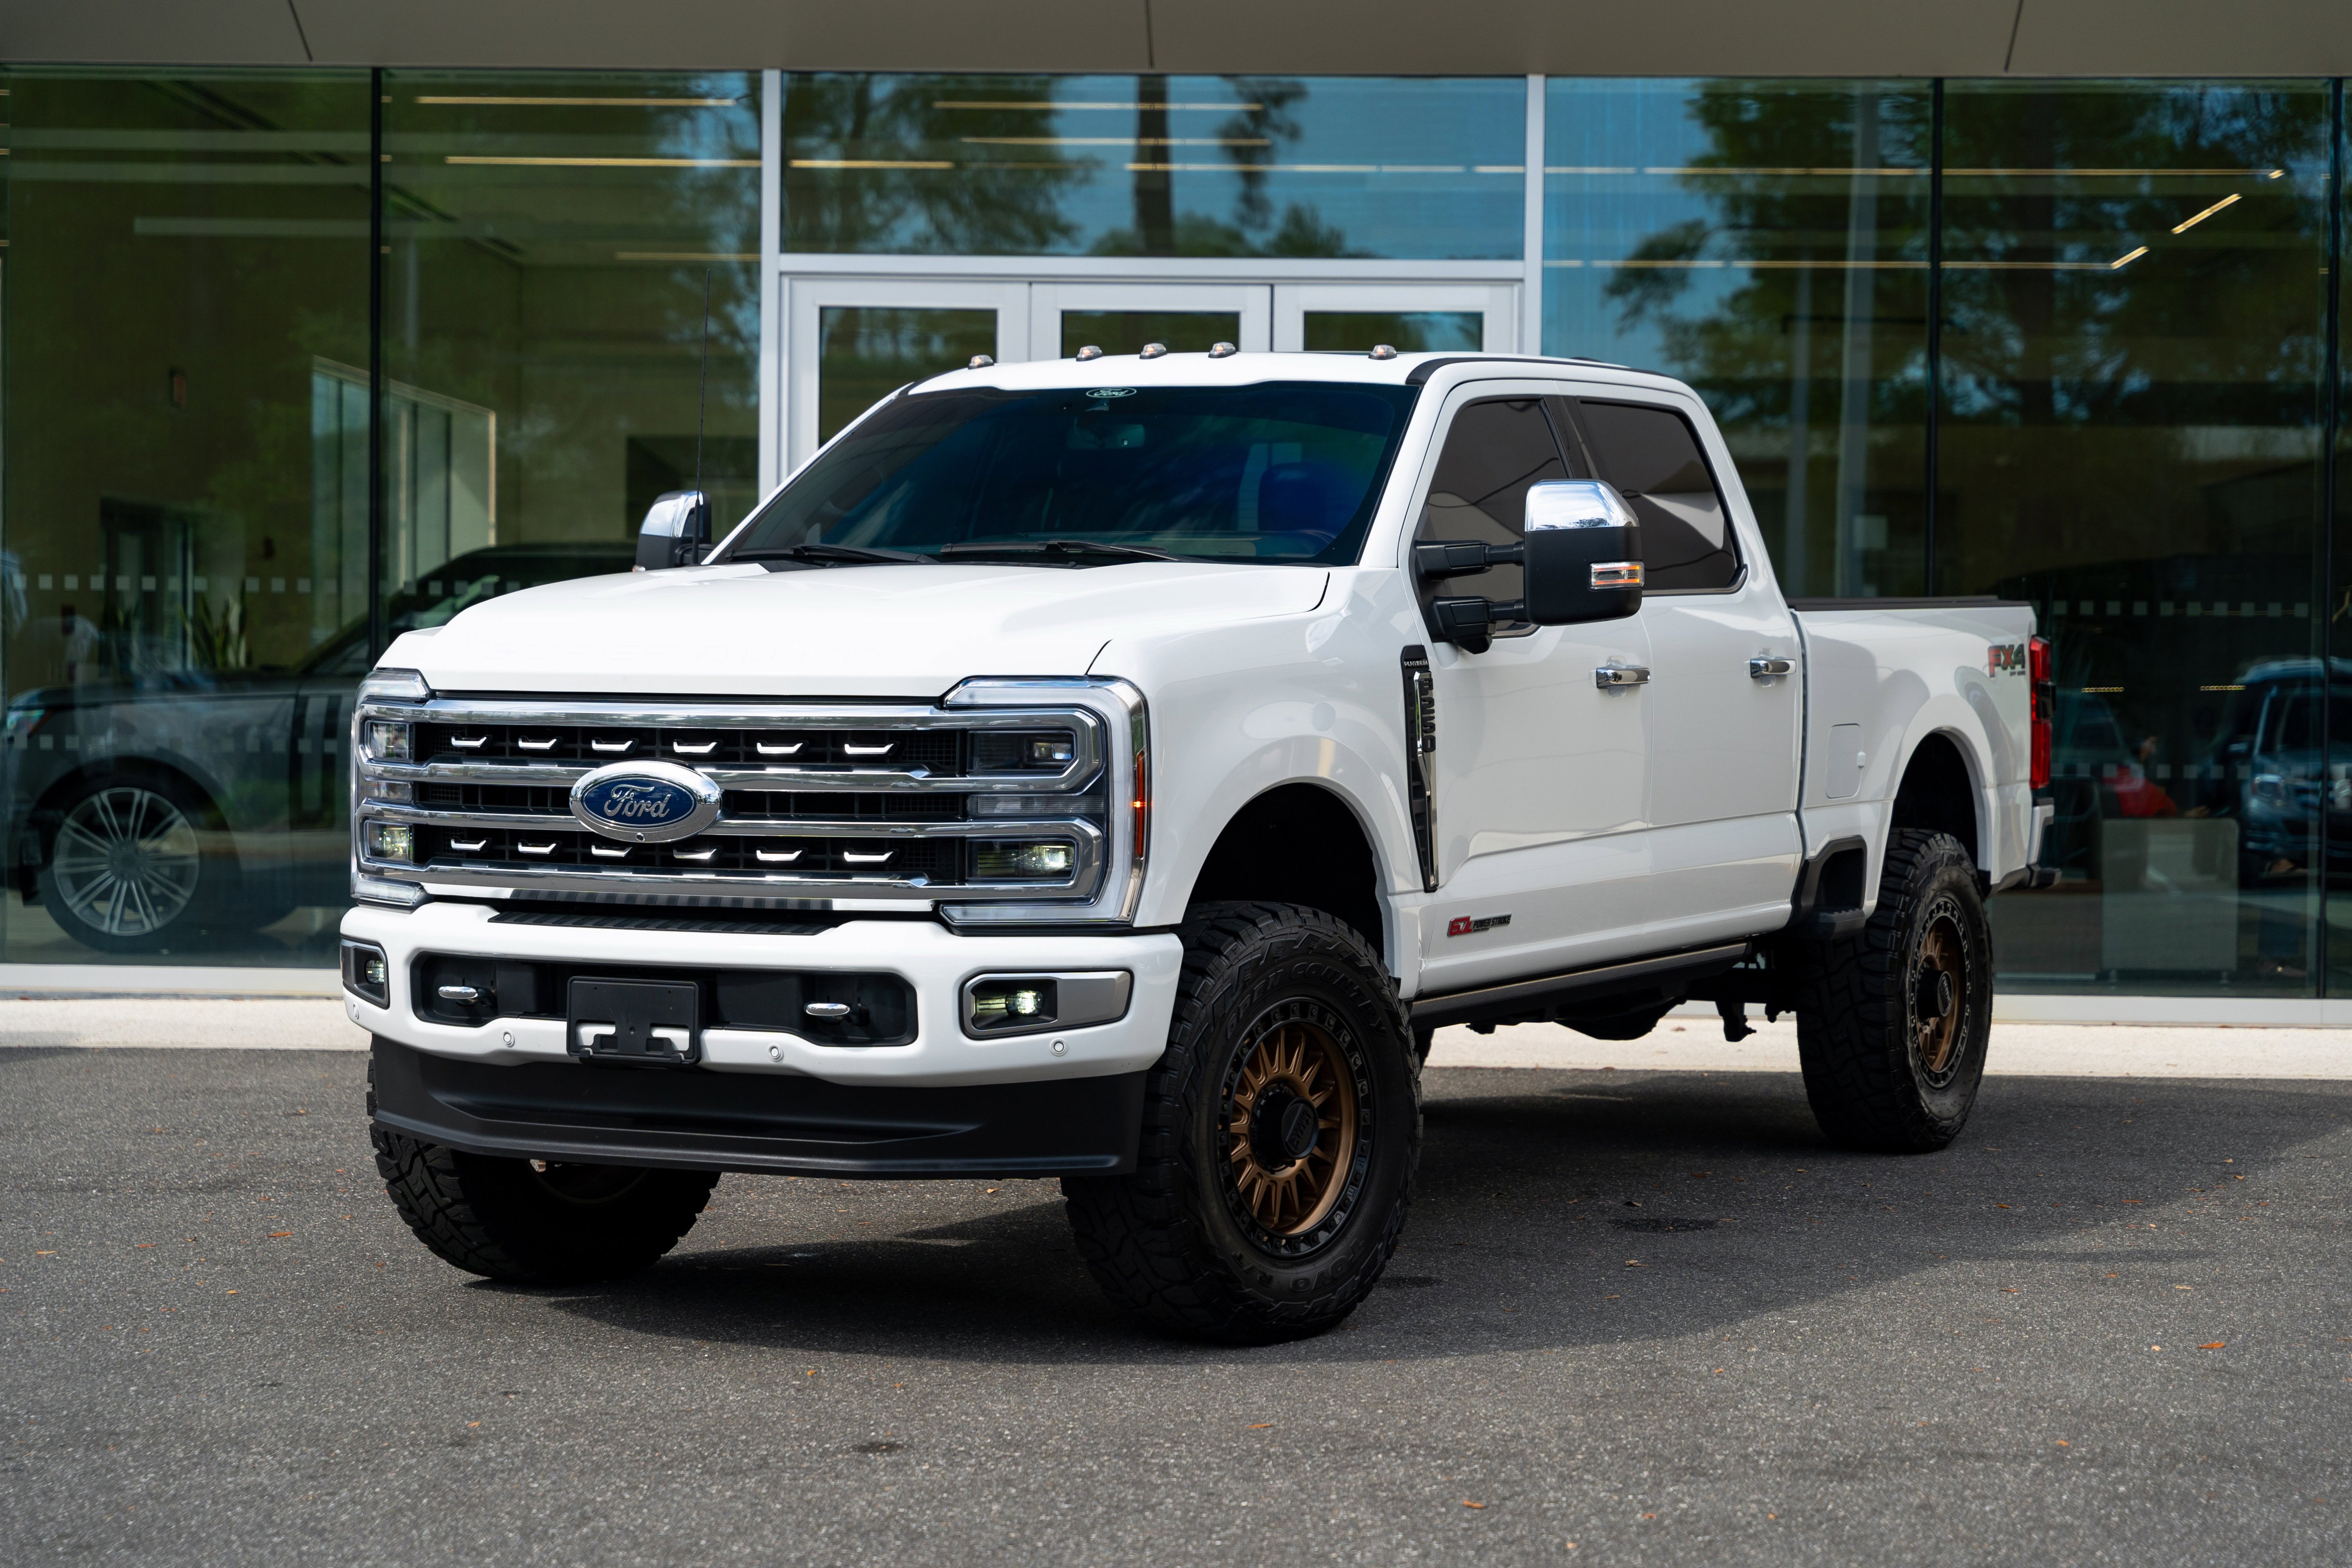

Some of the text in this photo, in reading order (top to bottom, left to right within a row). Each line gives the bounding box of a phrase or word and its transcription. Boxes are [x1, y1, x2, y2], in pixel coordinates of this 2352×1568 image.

[1988, 644, 2025, 677] FX4
[1421, 678, 1436, 753] F250
[604, 784, 671, 817] Ford
[1227, 962, 1388, 1040] OPEN COUNTRY
[1232, 1251, 1274, 1288] R/T
[1290, 1238, 1365, 1292] TOYO
